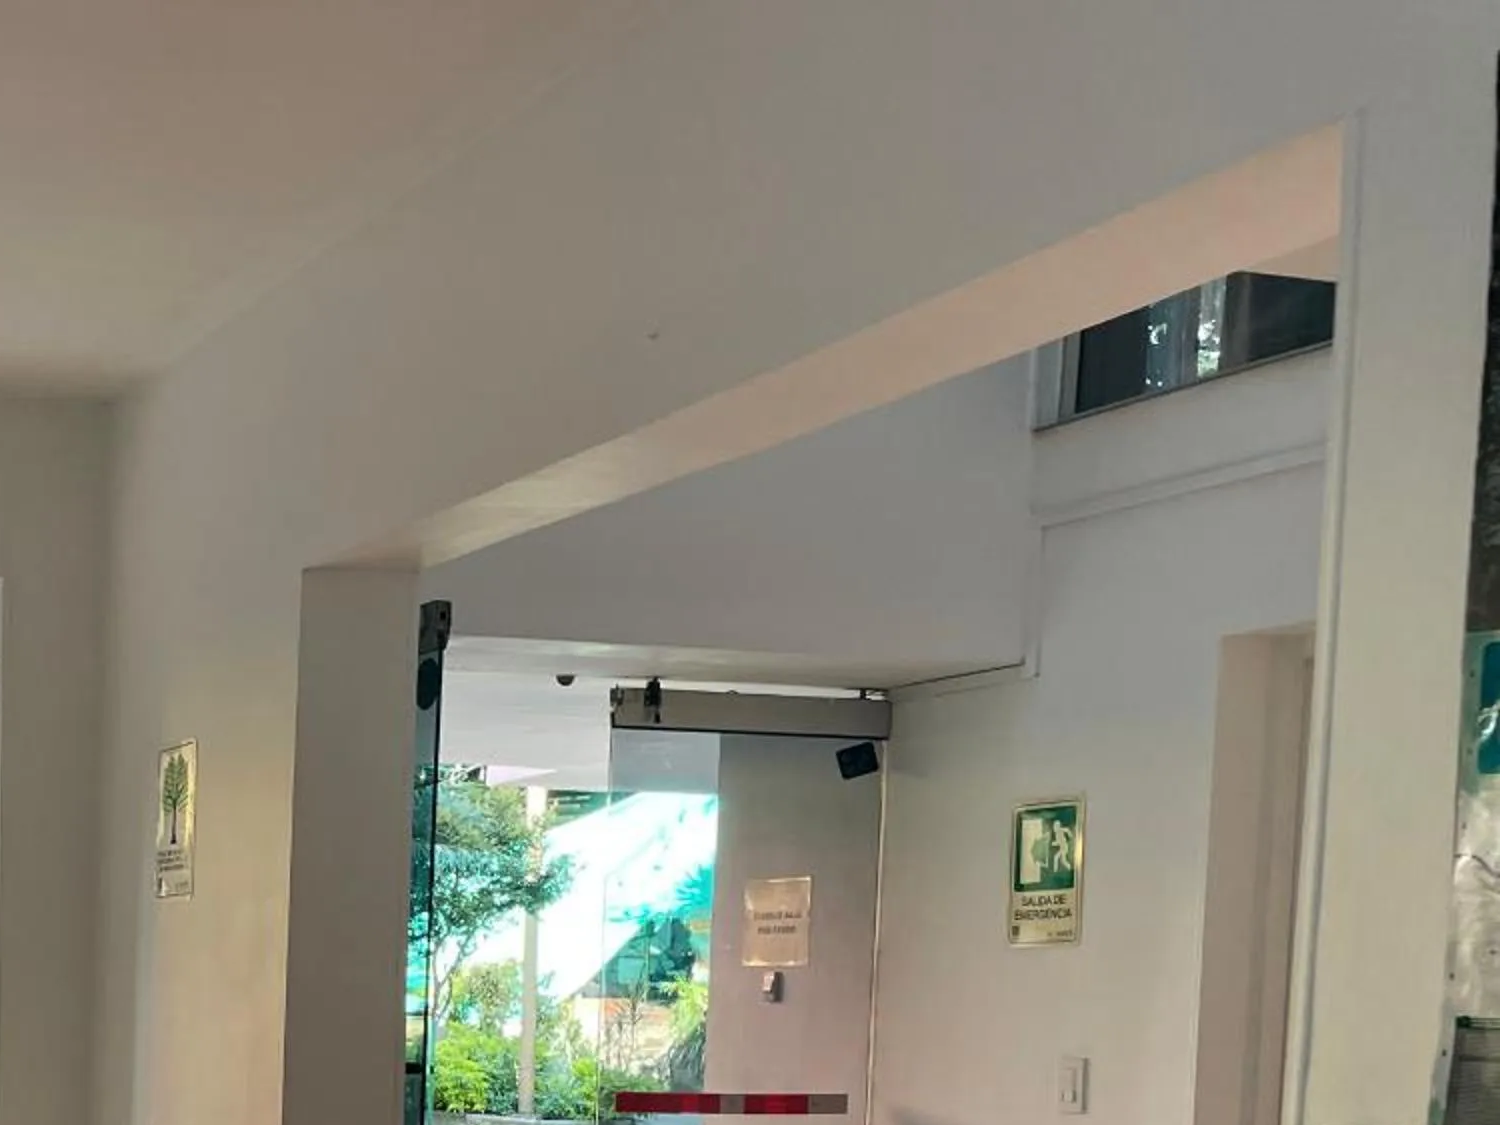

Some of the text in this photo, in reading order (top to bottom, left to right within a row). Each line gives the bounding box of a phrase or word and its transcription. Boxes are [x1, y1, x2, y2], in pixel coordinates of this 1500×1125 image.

[1021, 894, 1067, 907] SALIDA DE
[1013, 908, 1072, 921] EMERGENCIA
